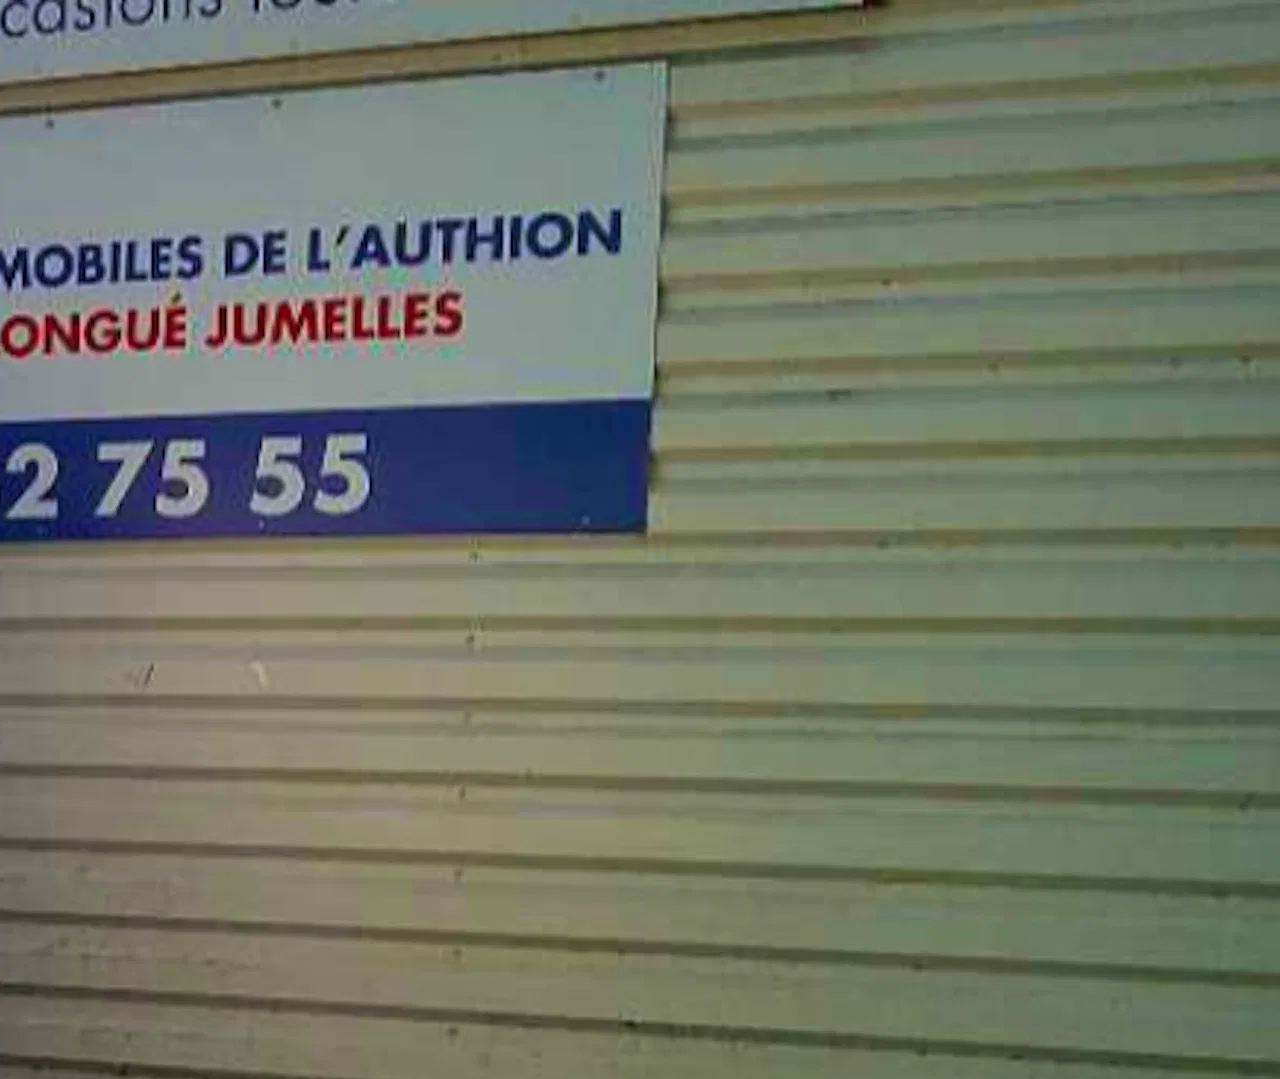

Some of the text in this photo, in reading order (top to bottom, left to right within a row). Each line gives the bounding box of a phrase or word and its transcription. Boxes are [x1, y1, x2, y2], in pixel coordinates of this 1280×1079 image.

[223, 229, 288, 278] DE
[306, 208, 623, 273] L'AUTHION
[205, 291, 463, 349] JUMELLES
[93, 437, 210, 520] 75
[249, 431, 371, 518] 55
